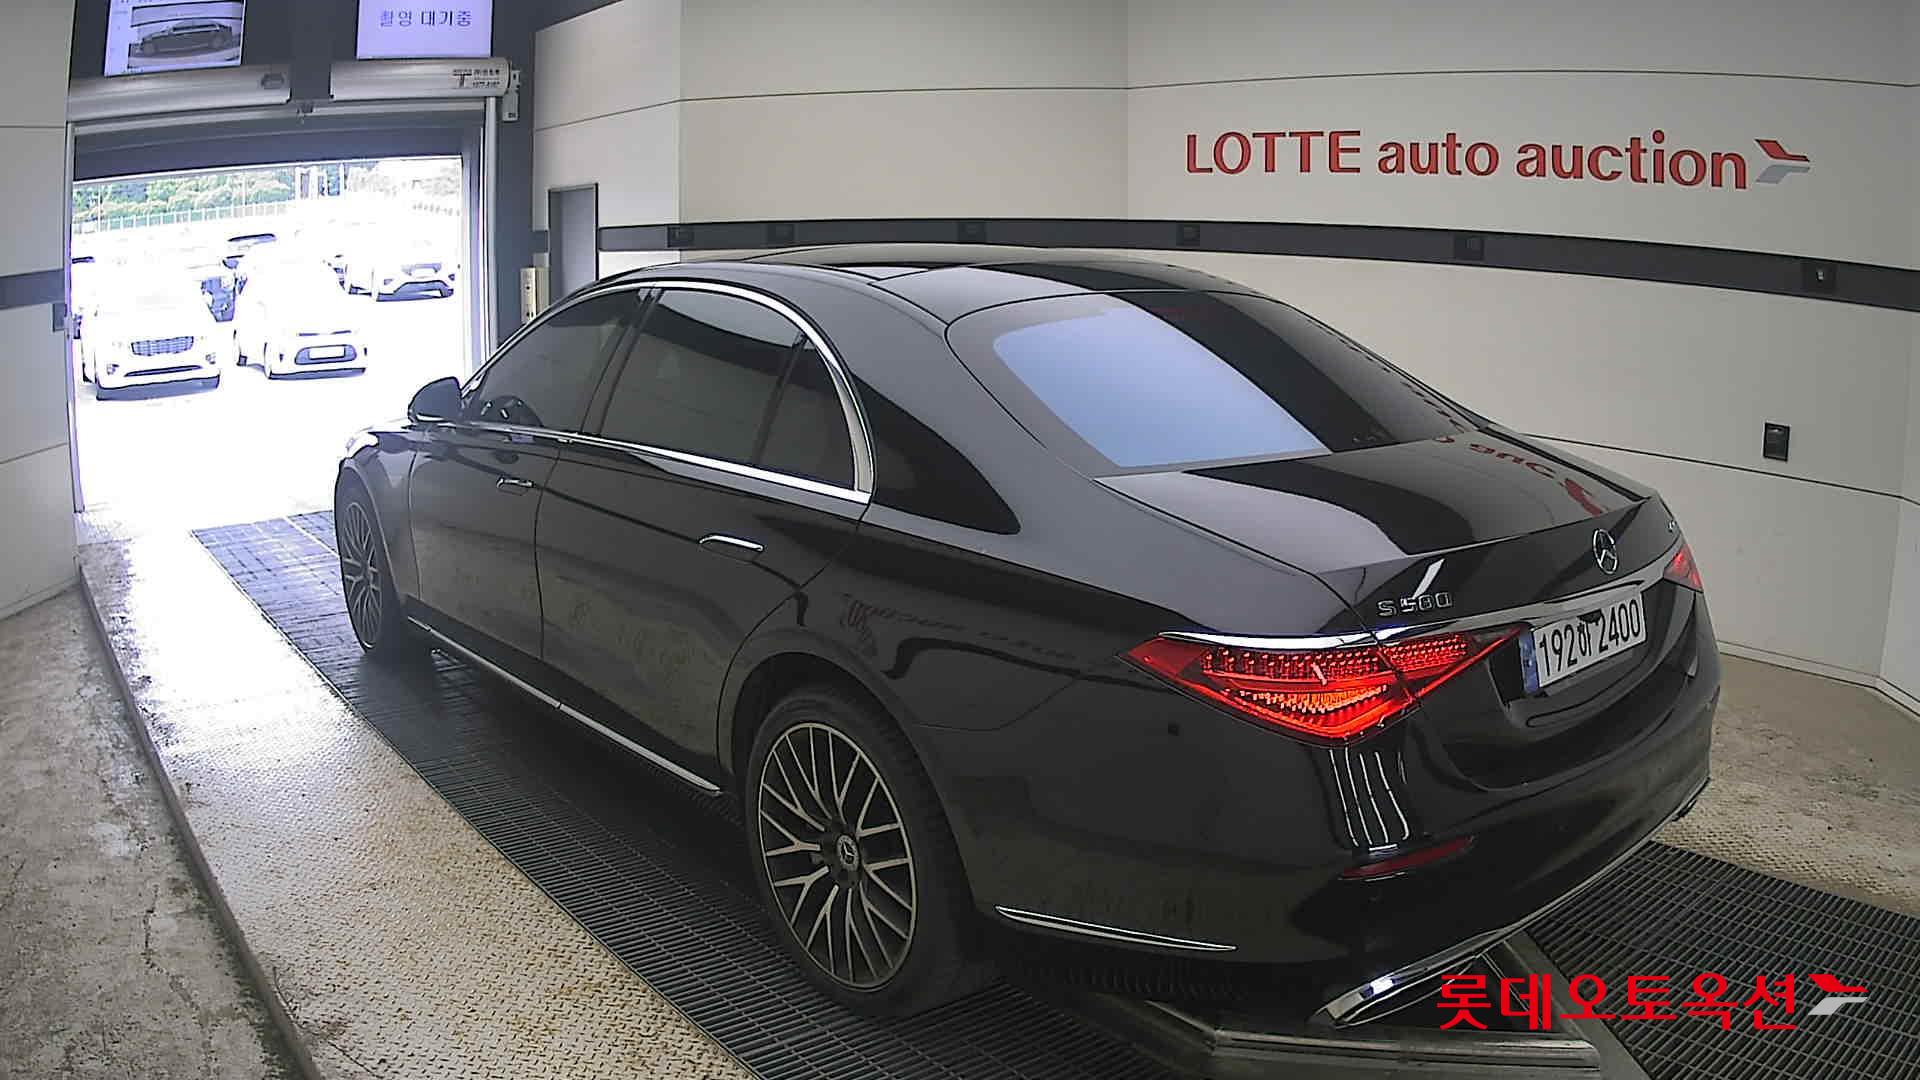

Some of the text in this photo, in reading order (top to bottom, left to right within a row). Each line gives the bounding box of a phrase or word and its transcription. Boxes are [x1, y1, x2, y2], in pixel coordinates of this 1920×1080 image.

[421, 9, 472, 27] 대기중
[1186, 129, 1747, 190] LOTTE auto auction
[1377, 592, 1452, 616] S 500
[1597, 598, 1642, 653] 2400
